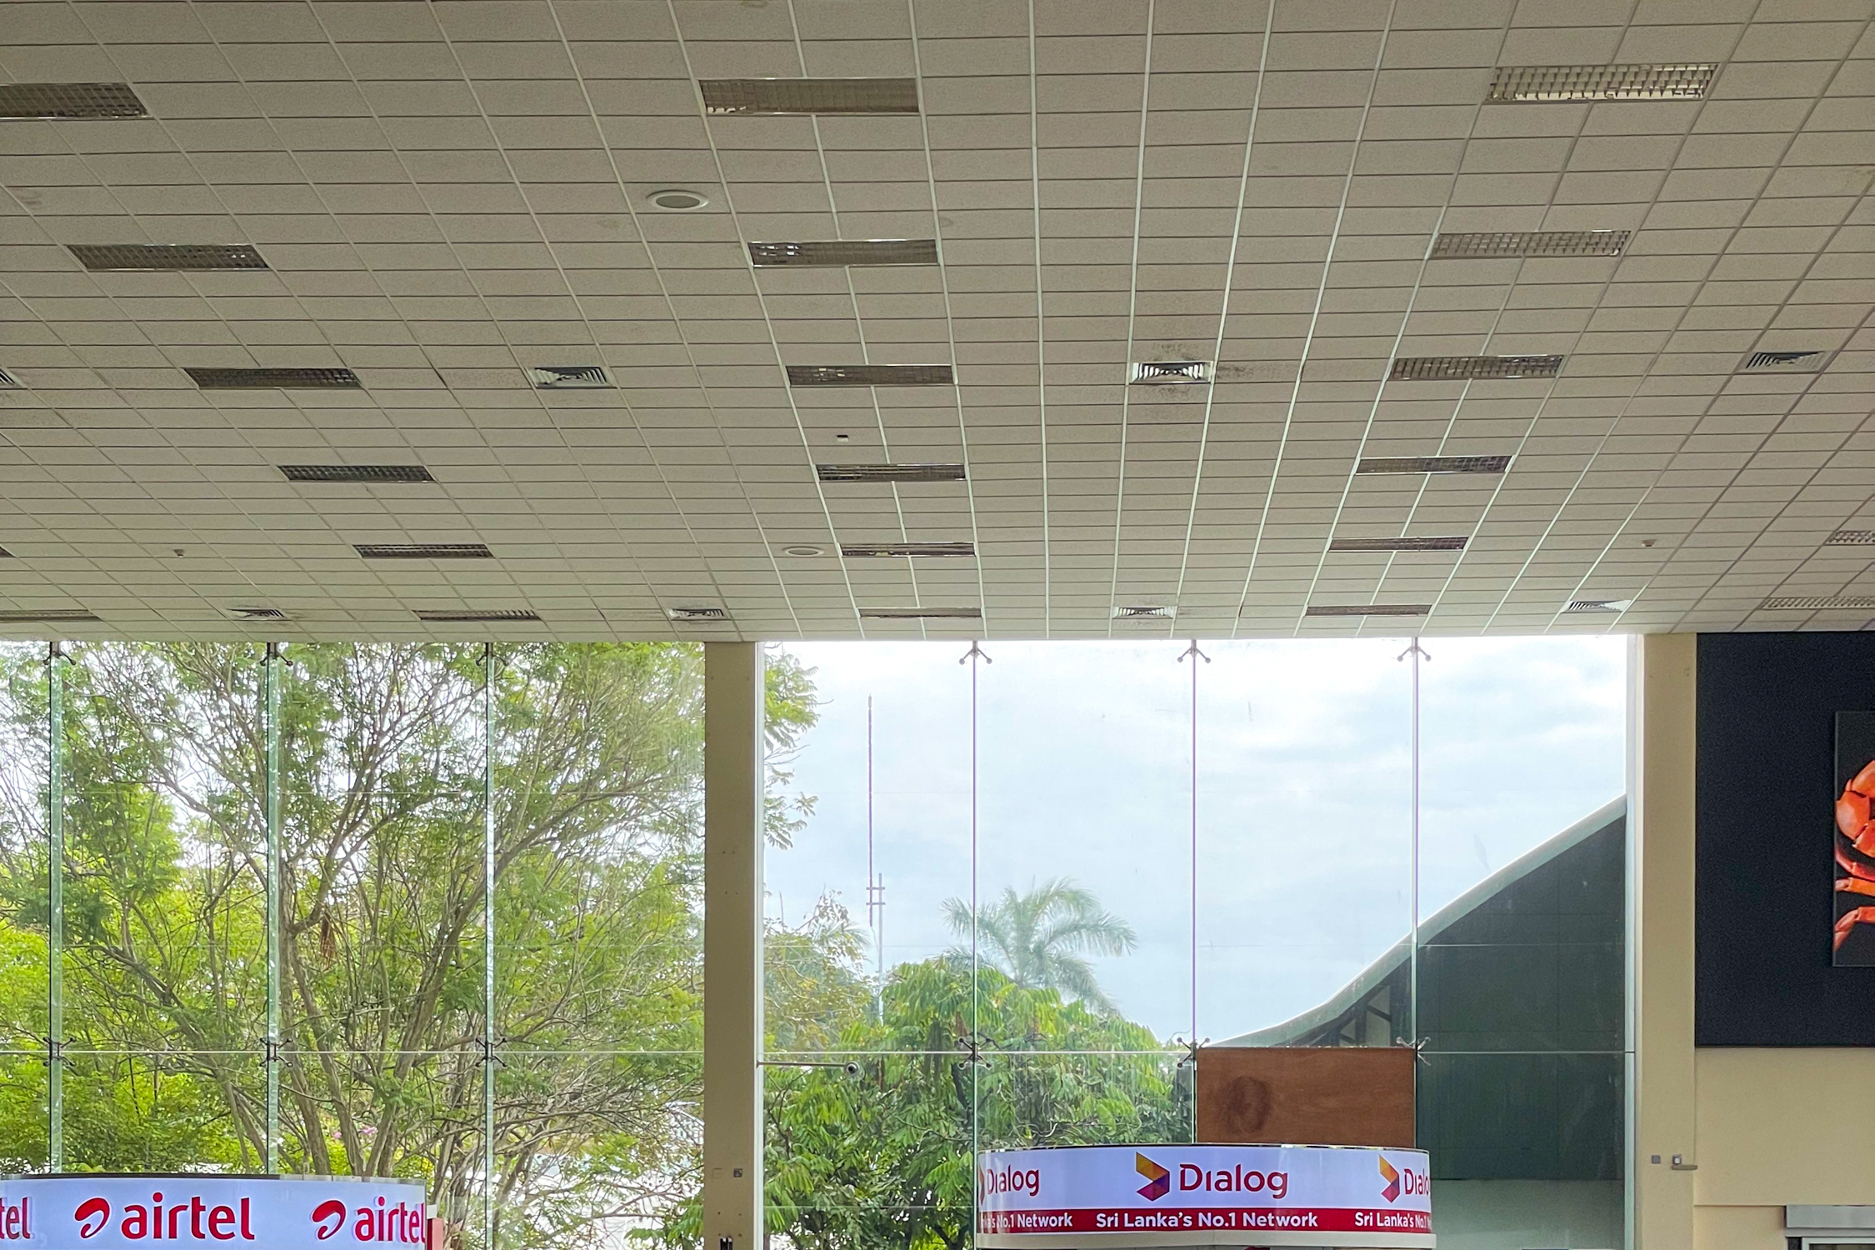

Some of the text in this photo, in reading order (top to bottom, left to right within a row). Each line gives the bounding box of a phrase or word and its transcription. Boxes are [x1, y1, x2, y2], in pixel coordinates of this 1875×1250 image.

[986, 1164, 1040, 1196] Dialog
[1179, 1163, 1288, 1199] Dialog
[121, 1192, 255, 1240] airtel
[355, 1196, 426, 1243] airtel
[1017, 1212, 1073, 1228] Network
[1096, 1212, 1119, 1228] Sri
[1198, 1212, 1236, 1228] No.1
[1242, 1212, 1318, 1228] Network
[1355, 1212, 1373, 1227] Sri
[1376, 1212, 1415, 1229] Lanka's
